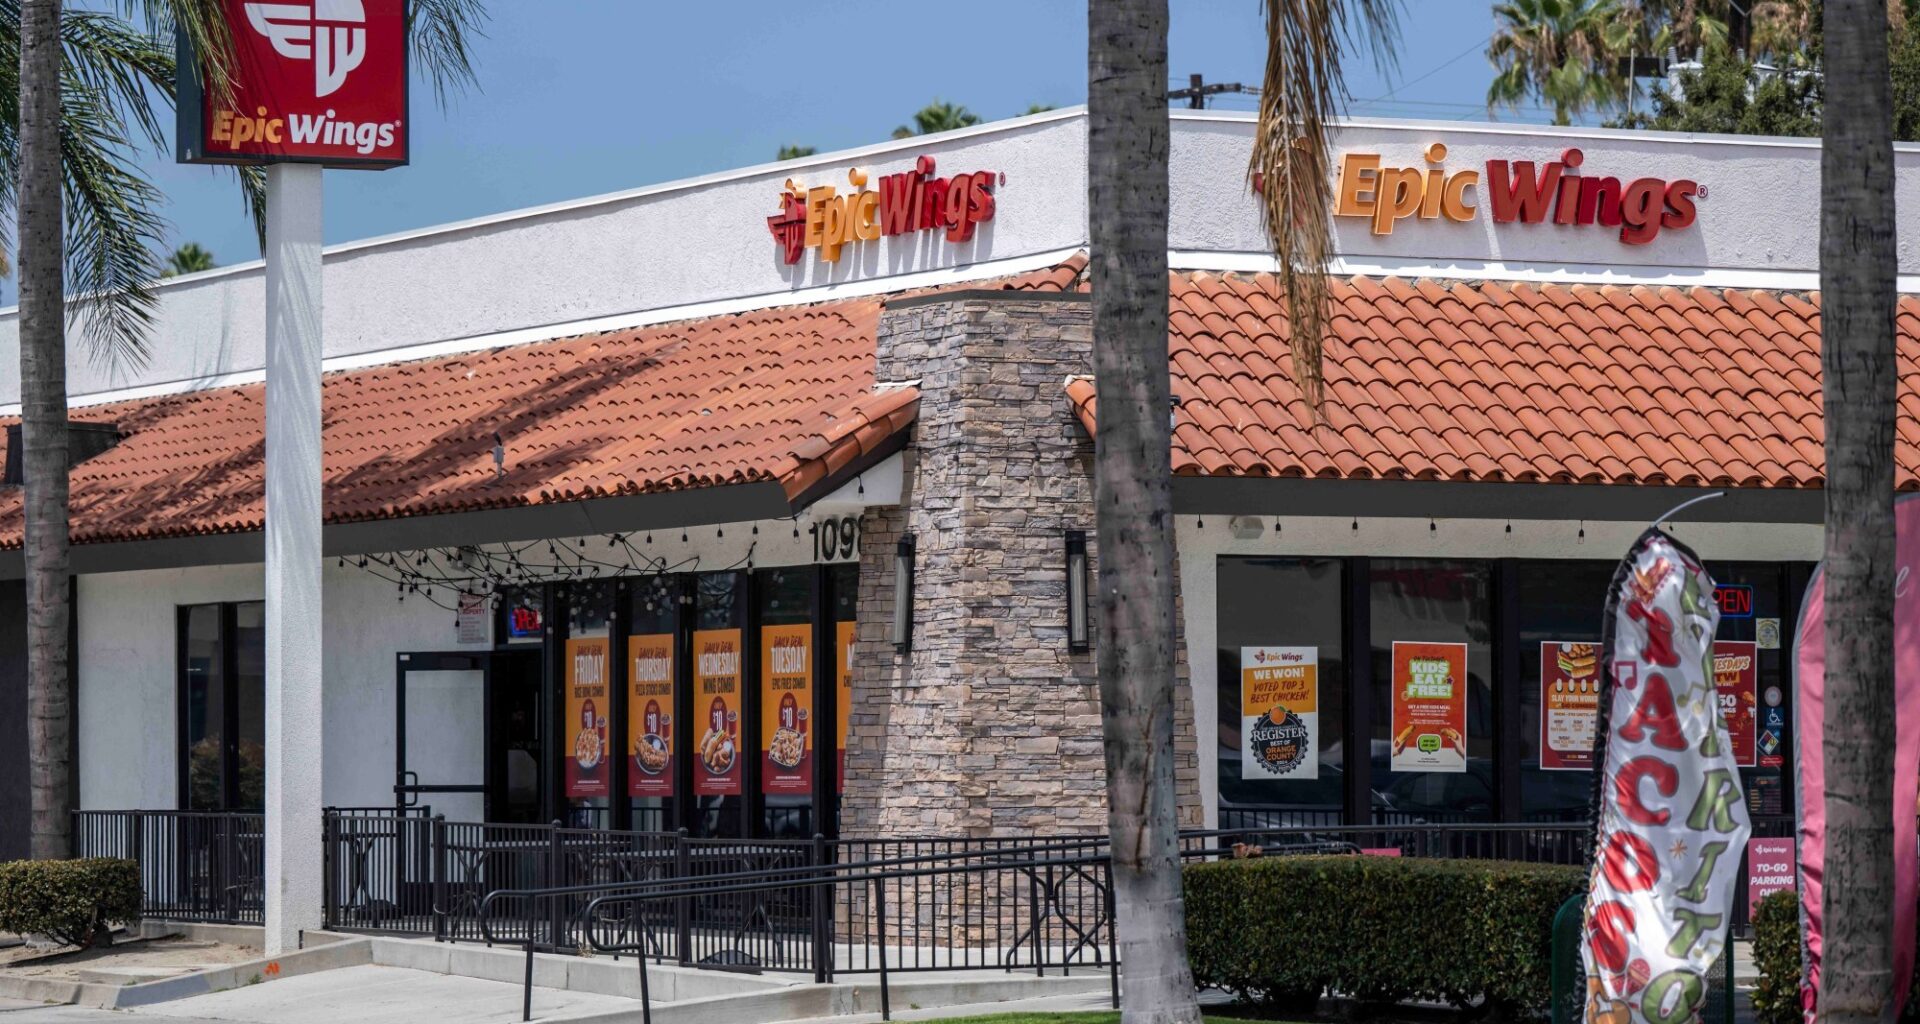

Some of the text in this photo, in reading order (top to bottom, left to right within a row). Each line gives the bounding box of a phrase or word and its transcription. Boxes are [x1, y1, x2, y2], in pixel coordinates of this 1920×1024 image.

[211, 106, 284, 150] Epic
[1334, 142, 1479, 235] Epic
[805, 167, 880, 262] Epic
[1712, 588, 1751, 612] PEN
[698, 651, 739, 676] WEDNESDAY
[770, 646, 807, 674] TUESDAY
[1714, 656, 1751, 672] ESDAYS
[575, 654, 604, 685] FRIDAY
[635, 657, 671, 682] THURSDAY
[1253, 667, 1305, 680] WE WON!
[1411, 662, 1449, 674] KIDS
[1253, 680, 1304, 692] VOTED TOP 3
[1414, 673, 1445, 684] EAT
[1250, 690, 1309, 704] BEST CHICKEN!
[1408, 684, 1452, 696] FREE!
[713, 710, 723, 731] $10
[783, 707, 793, 728] $10
[1252, 727, 1306, 742] REGISTER
[1265, 745, 1296, 754] ORANGE
[1266, 753, 1296, 761] COUNTY
[1756, 863, 1788, 872] TO-GO
[1750, 875, 1794, 886] PARKING
